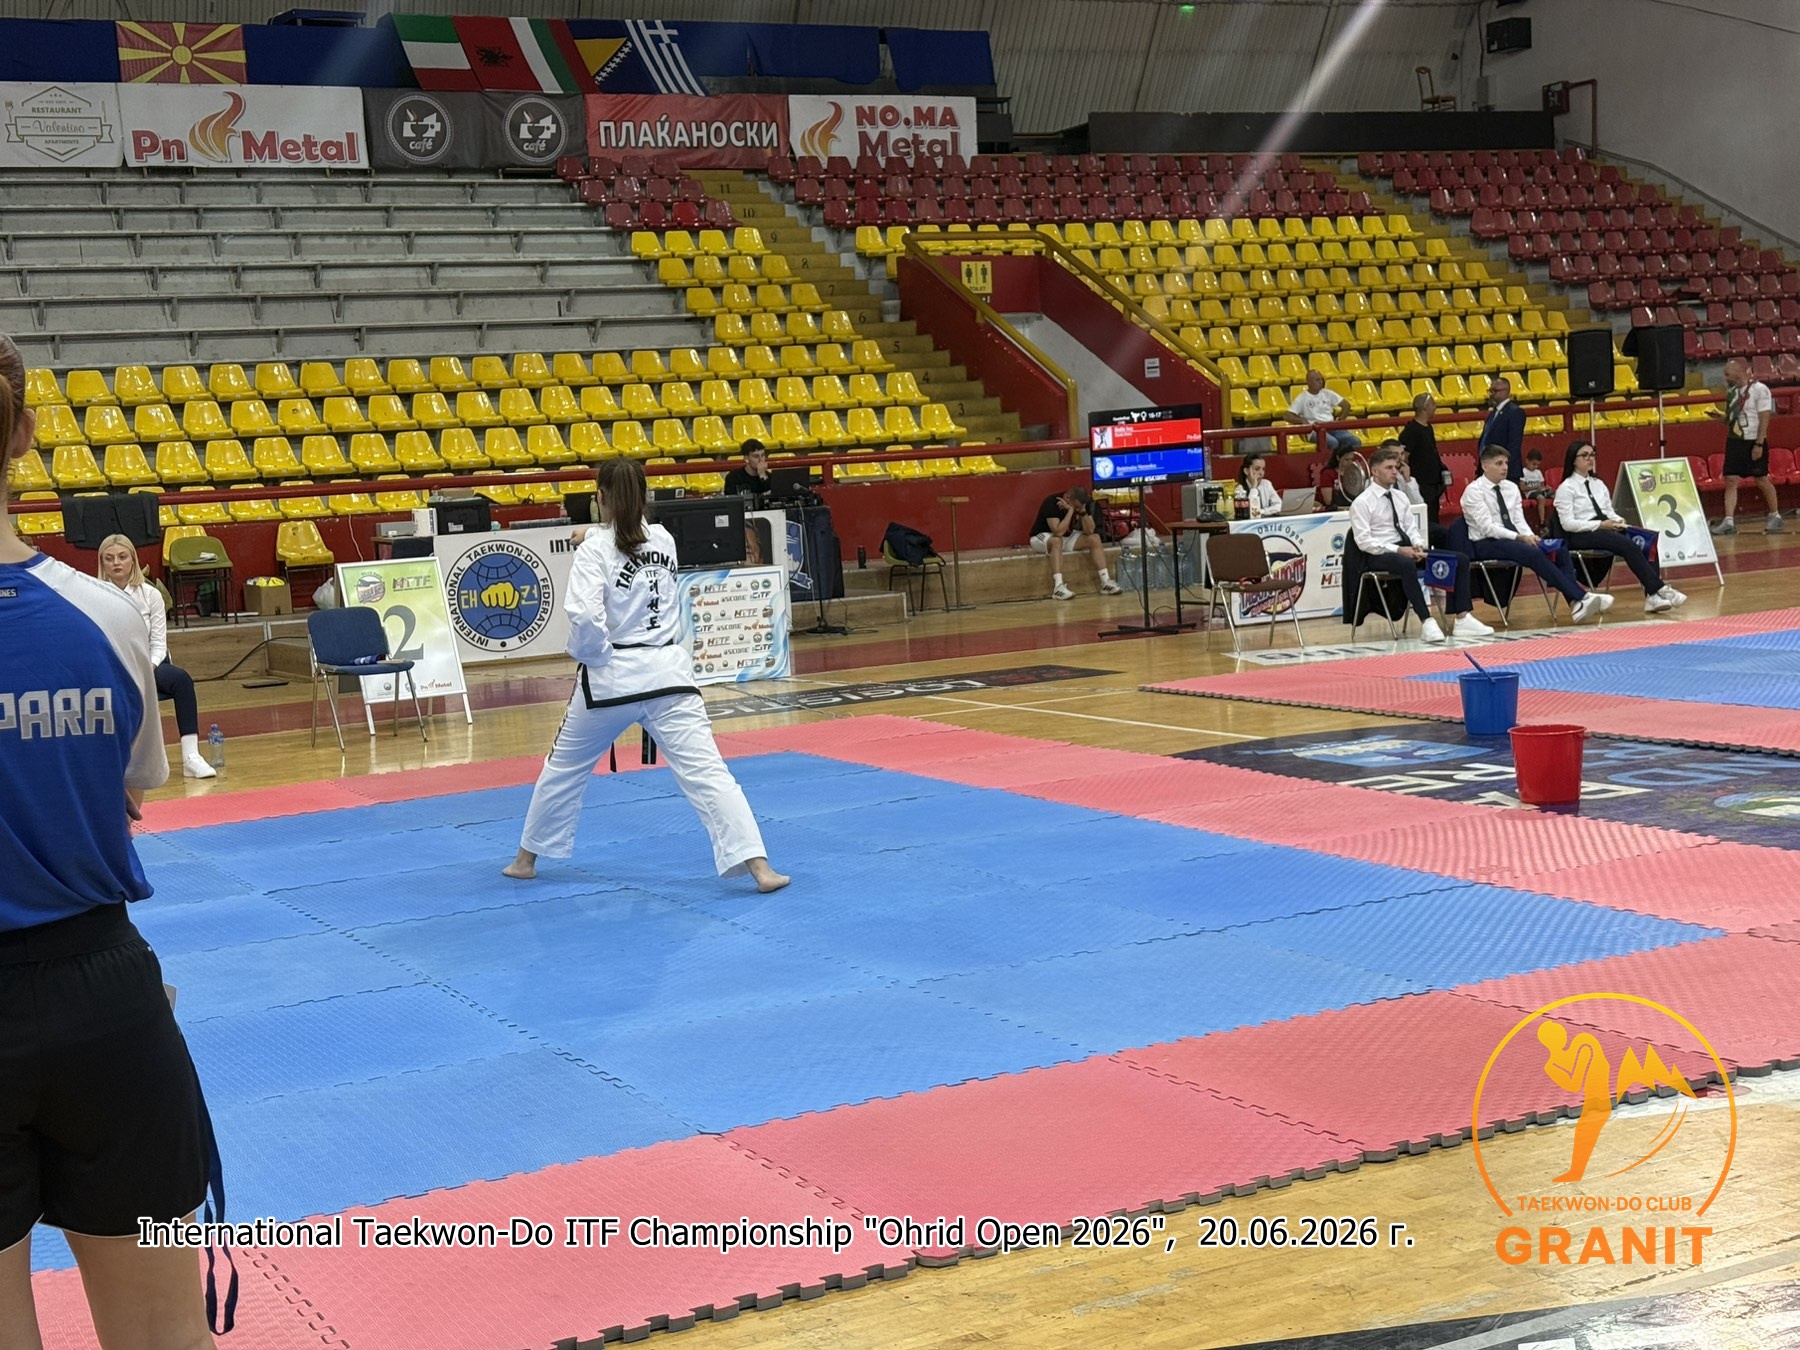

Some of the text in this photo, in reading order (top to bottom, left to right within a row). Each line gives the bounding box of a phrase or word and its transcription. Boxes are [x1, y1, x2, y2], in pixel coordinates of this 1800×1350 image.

[855, 104, 960, 129] NO.MA
[598, 114, 779, 148] ПЛАЌАНОСКИ
[131, 129, 359, 162] Pn Metal
[409, 138, 433, 153] café
[523, 141, 546, 154] café
[857, 130, 961, 161] Metal
[743, 207, 755, 218] 10
[770, 231, 778, 243] 9
[801, 258, 809, 269] 8
[828, 284, 836, 296] 7
[858, 311, 866, 323] 6
[894, 341, 900, 353] 5
[922, 371, 931, 384] 4
[957, 402, 966, 417] 3
[1657, 493, 1686, 539] 3
[1257, 523, 1304, 545] Ohrid Open
[645, 569, 659, 578] ITF
[447, 543, 551, 648] INTERNATIONAL TAEKWON-DO FEDERATION
[383, 605, 424, 660] 2
